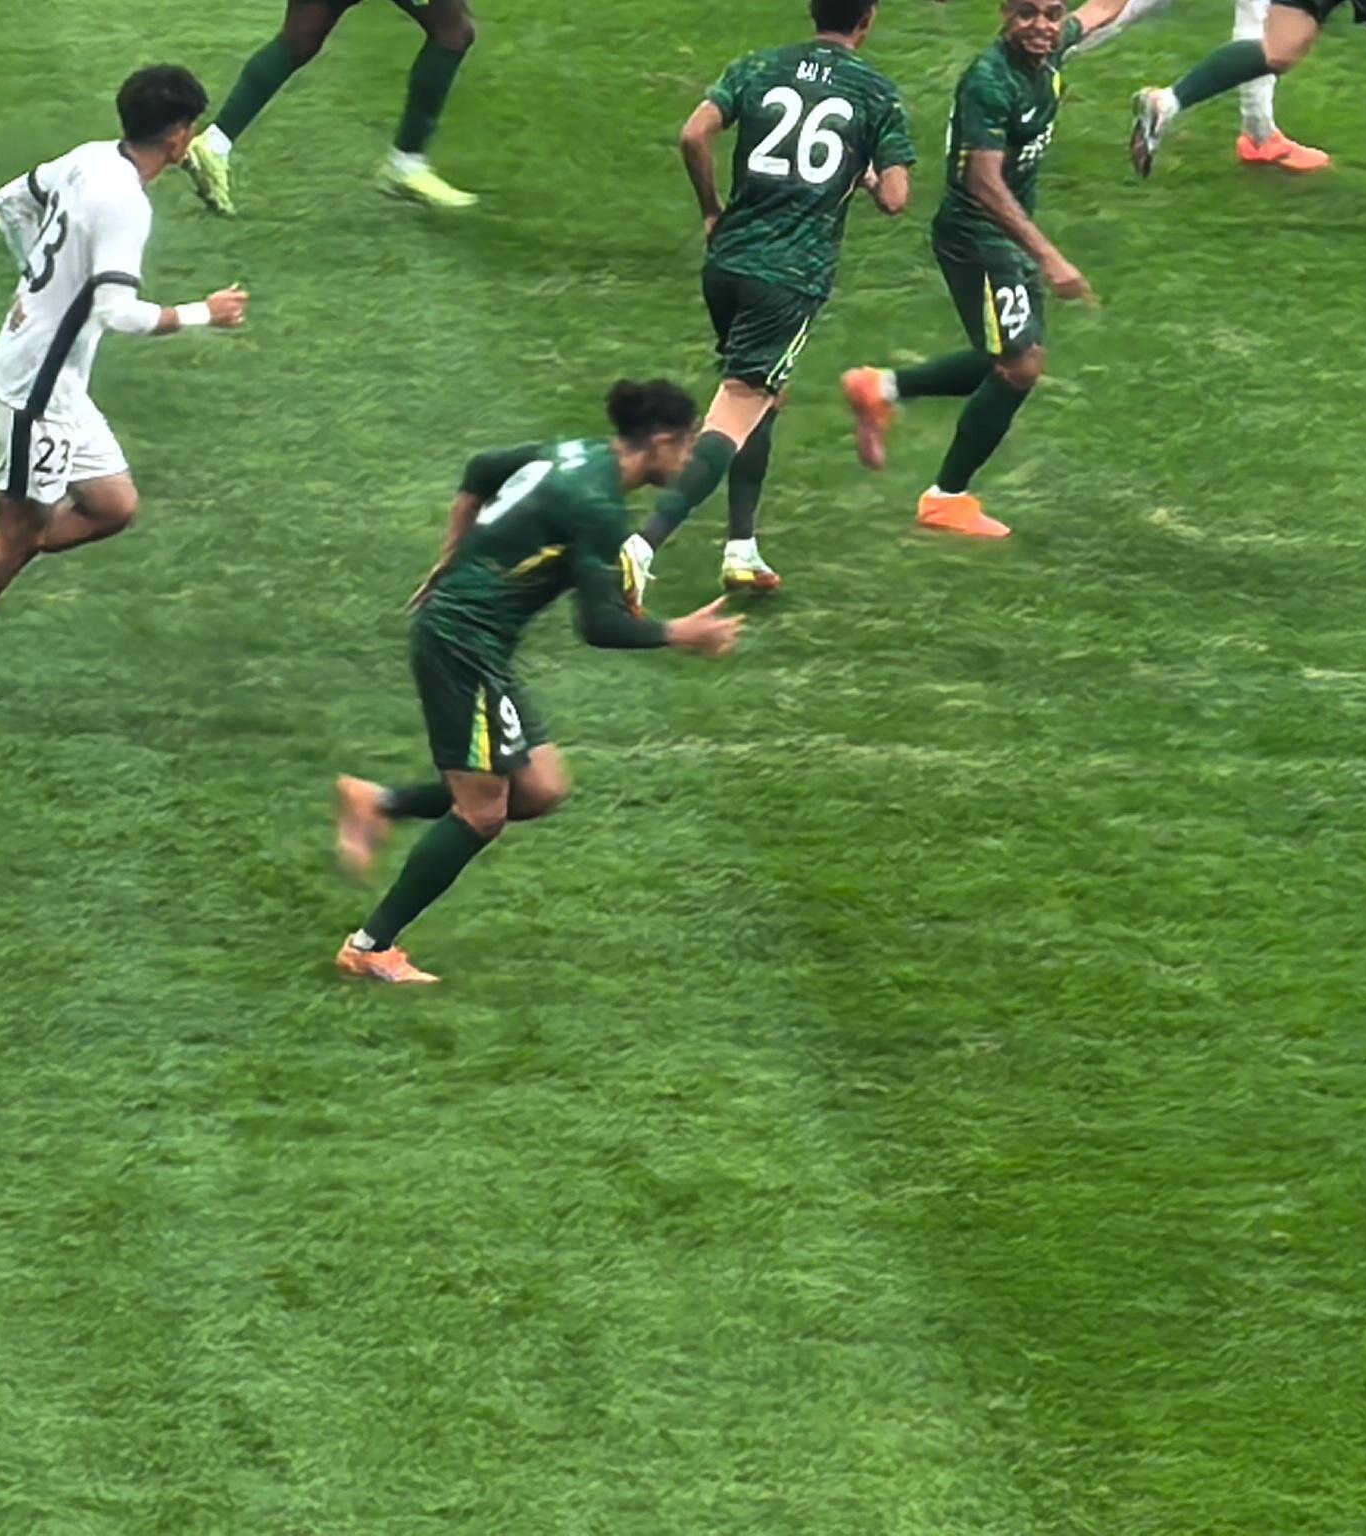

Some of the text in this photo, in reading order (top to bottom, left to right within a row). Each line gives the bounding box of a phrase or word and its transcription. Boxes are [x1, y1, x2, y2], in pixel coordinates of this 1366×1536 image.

[748, 86, 853, 184] 26
[995, 283, 1031, 327] 23
[35, 436, 72, 475] 23
